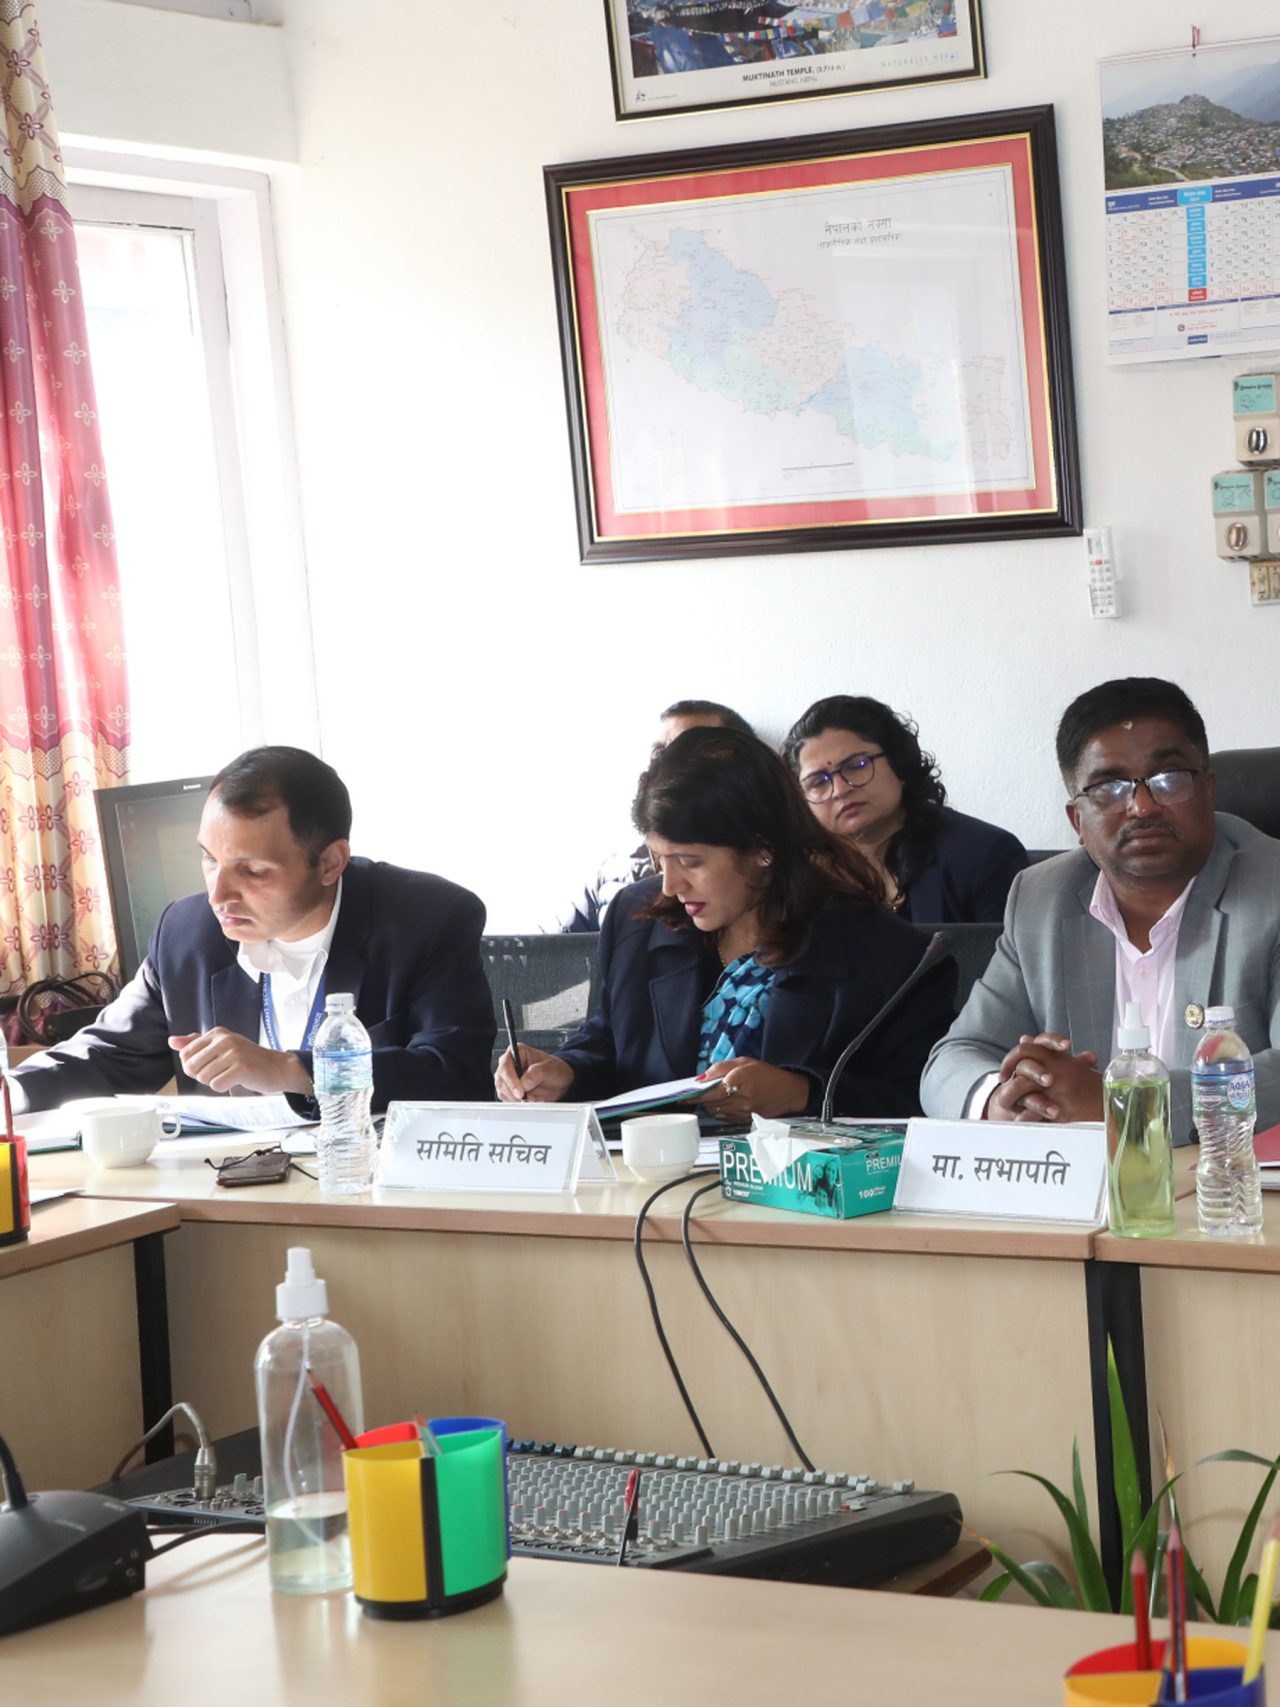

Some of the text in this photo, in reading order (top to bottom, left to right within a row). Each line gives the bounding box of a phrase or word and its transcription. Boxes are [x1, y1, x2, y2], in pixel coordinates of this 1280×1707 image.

[742, 70, 785, 82] MUKTINATH
[416, 1132, 552, 1165] समिति सचिव
[722, 1150, 813, 1192] PREUM
[932, 1150, 1071, 1186] मा. सभापति
